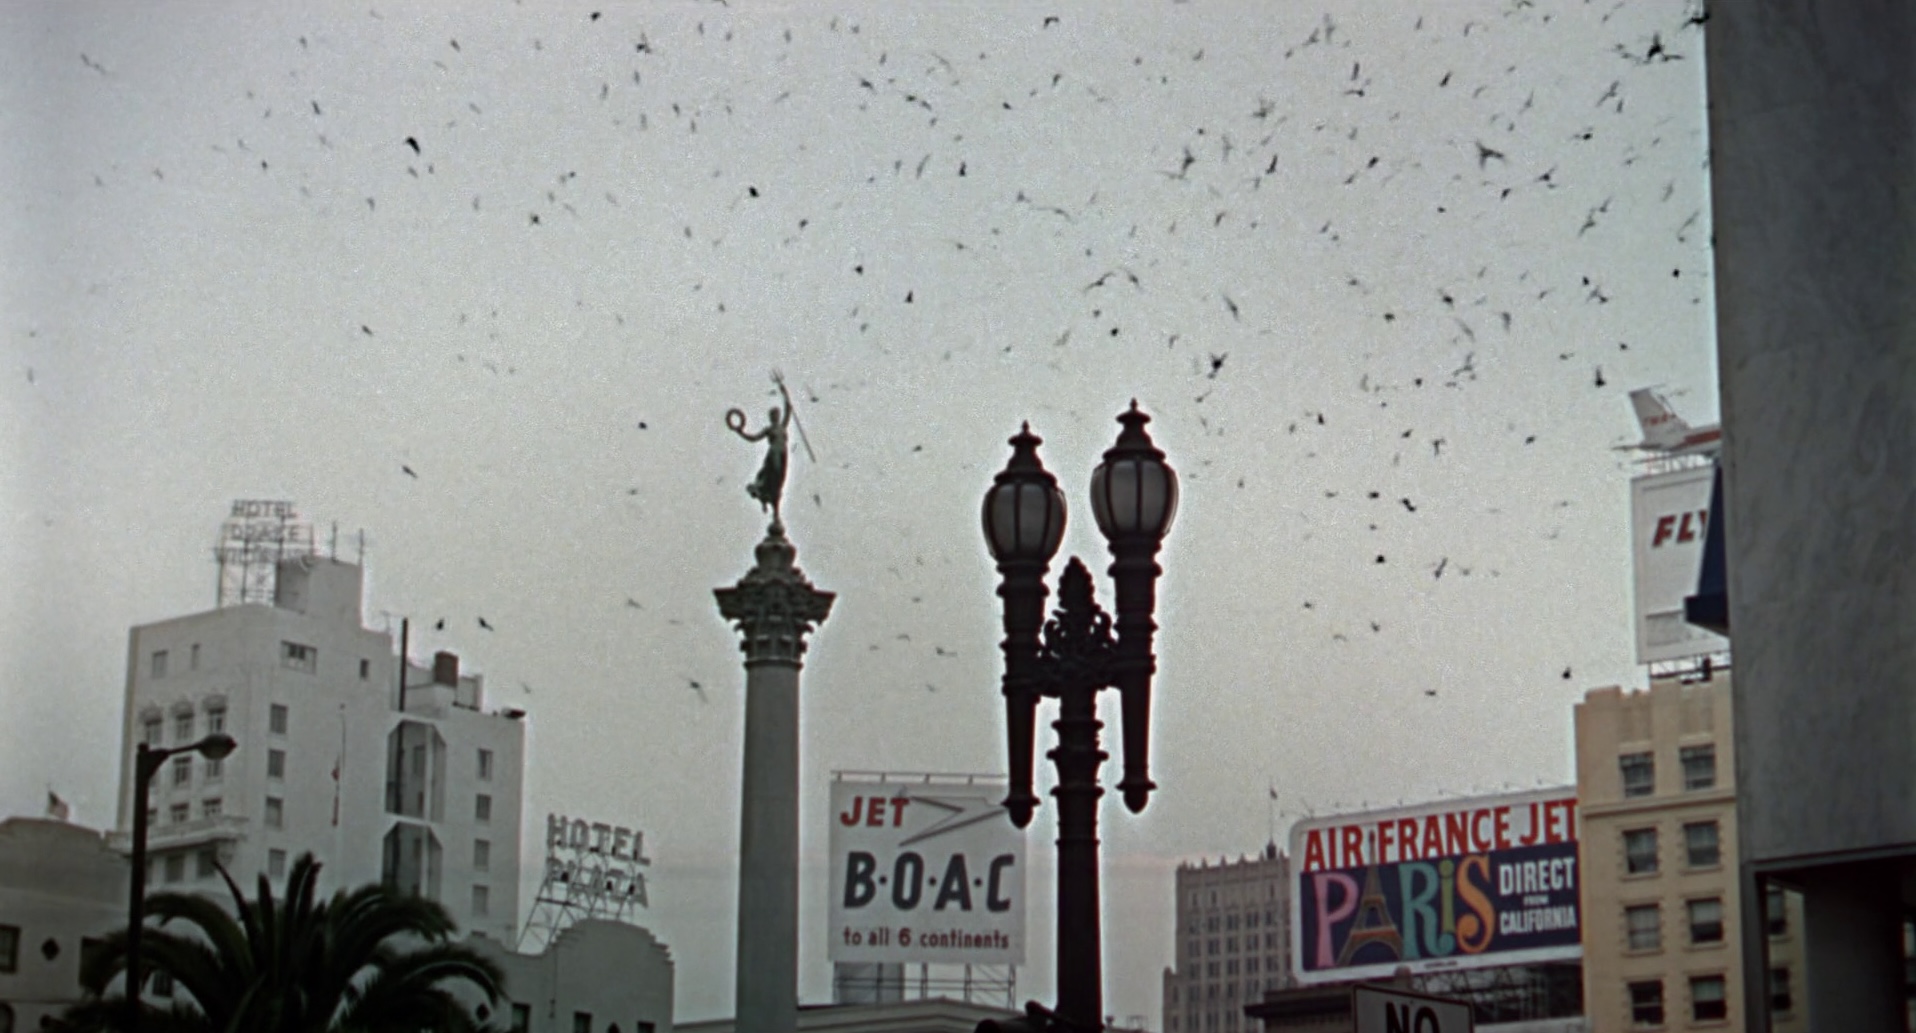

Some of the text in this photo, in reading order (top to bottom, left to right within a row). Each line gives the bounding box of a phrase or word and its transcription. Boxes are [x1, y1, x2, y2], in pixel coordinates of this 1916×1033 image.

[232, 500, 298, 518] HOTEL
[840, 796, 909, 828] JET
[548, 813, 651, 866] HOTEL
[1304, 827, 1363, 871] AIR
[1377, 807, 1510, 864] FRANCE
[547, 857, 648, 908] PLAZA
[1499, 856, 1575, 896] DIRECT
[1500, 905, 1577, 935] CALIFORNIA
[844, 928, 1009, 949] to all 6 continents
